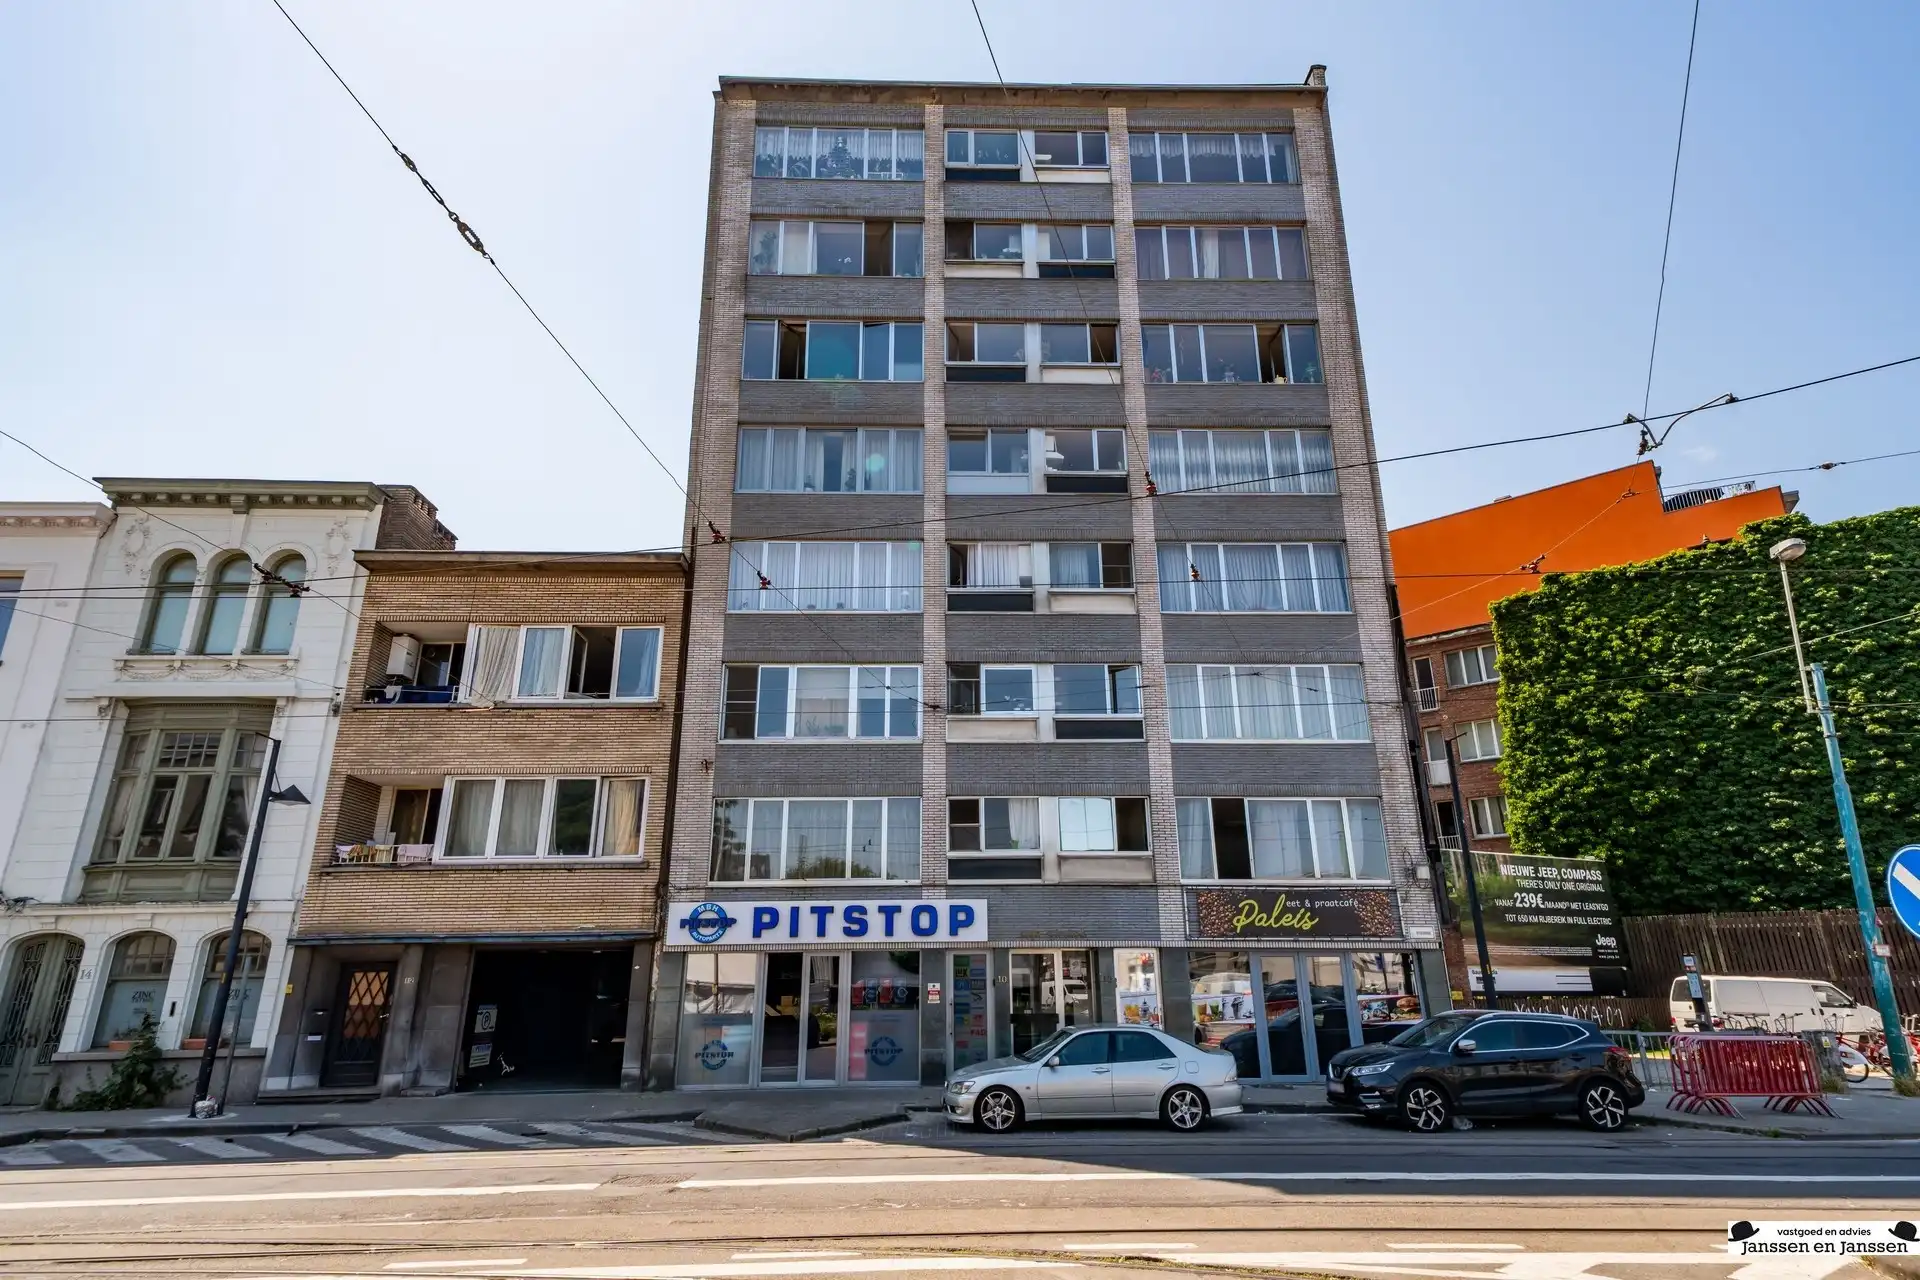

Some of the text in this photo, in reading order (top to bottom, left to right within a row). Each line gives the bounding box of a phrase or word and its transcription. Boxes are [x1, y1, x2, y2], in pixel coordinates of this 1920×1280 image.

[1500, 864, 1536, 877] NIEUWE
[1561, 868, 1602, 881] COMPASS
[1516, 879, 1605, 892] THERE'S ONLY ONE ORIGINAL
[697, 903, 719, 913] MBH
[1286, 898, 1359, 909] eet & praatcafé
[1494, 898, 1514, 907] VANAF
[1570, 902, 1582, 910] MET
[1233, 893, 1319, 933] Paleis
[679, 917, 738, 929] PITSTOP
[752, 904, 975, 938] PITSTOP
[1505, 914, 1516, 922] TOT
[1529, 915, 1538, 923] KM
[1567, 916, 1574, 924] IN
[1574, 916, 1587, 925] FULL
[1587, 917, 1612, 925] ELECTRIC
[692, 931, 723, 942] AUTOPARTS
[1595, 933, 1616, 948] Jeep
[79, 969, 92, 980] 14
[997, 975, 1007, 983] 10
